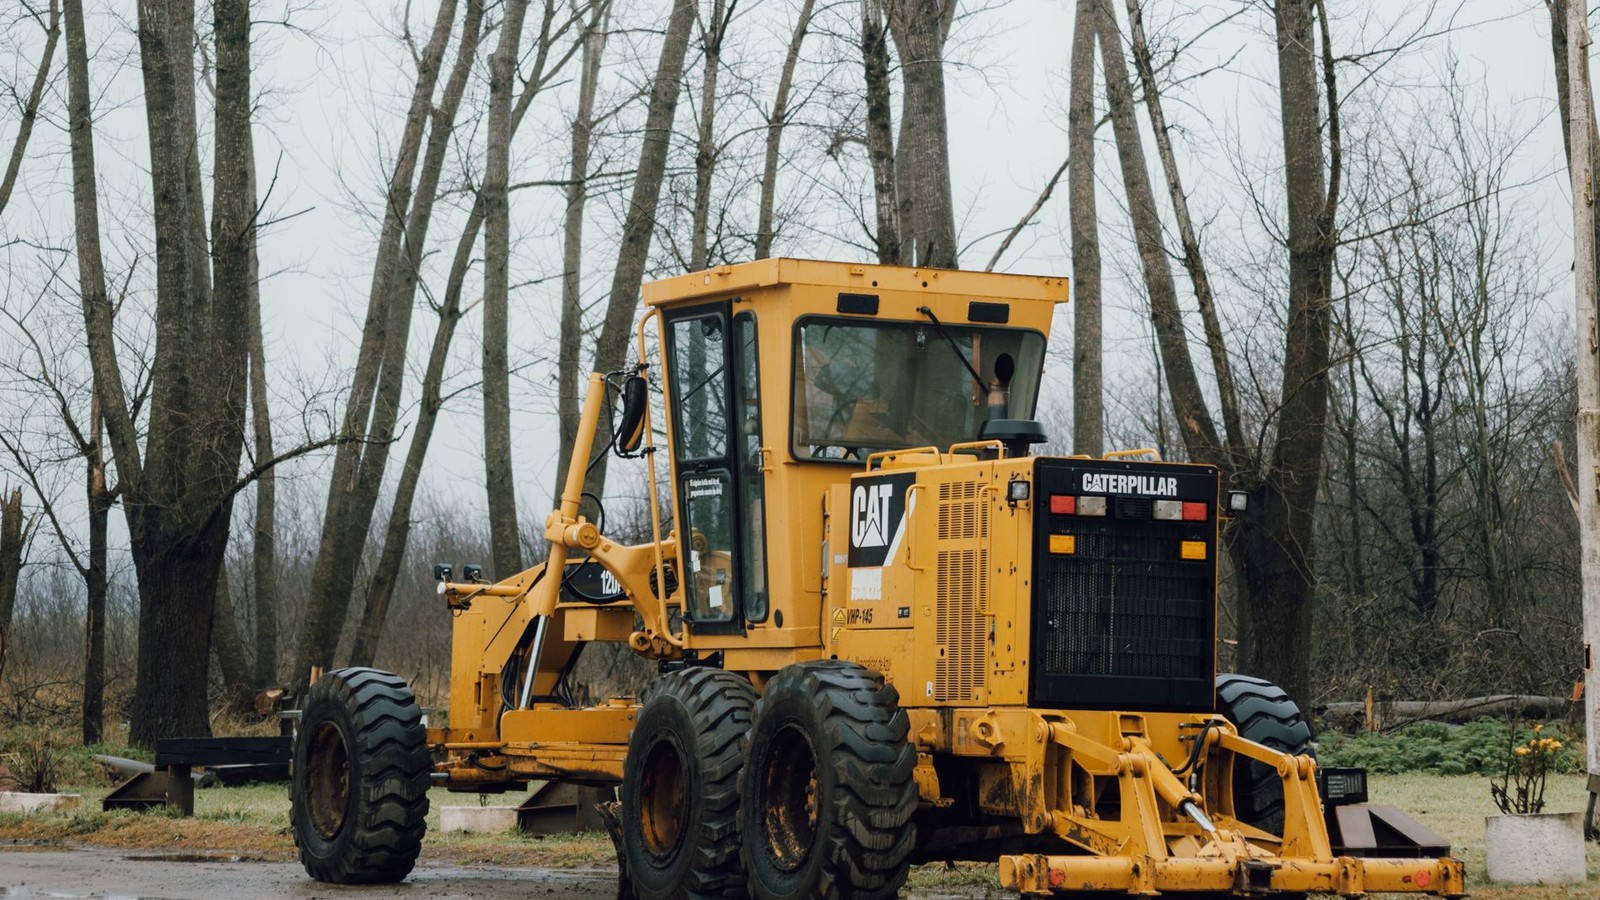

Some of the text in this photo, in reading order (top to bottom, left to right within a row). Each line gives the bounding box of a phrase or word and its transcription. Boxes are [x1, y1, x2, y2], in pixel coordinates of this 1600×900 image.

[1082, 472, 1177, 496] CATERPILLAR
[851, 483, 893, 548] CAT
[601, 569, 621, 595] 120
[847, 608, 873, 624] VHP-145
